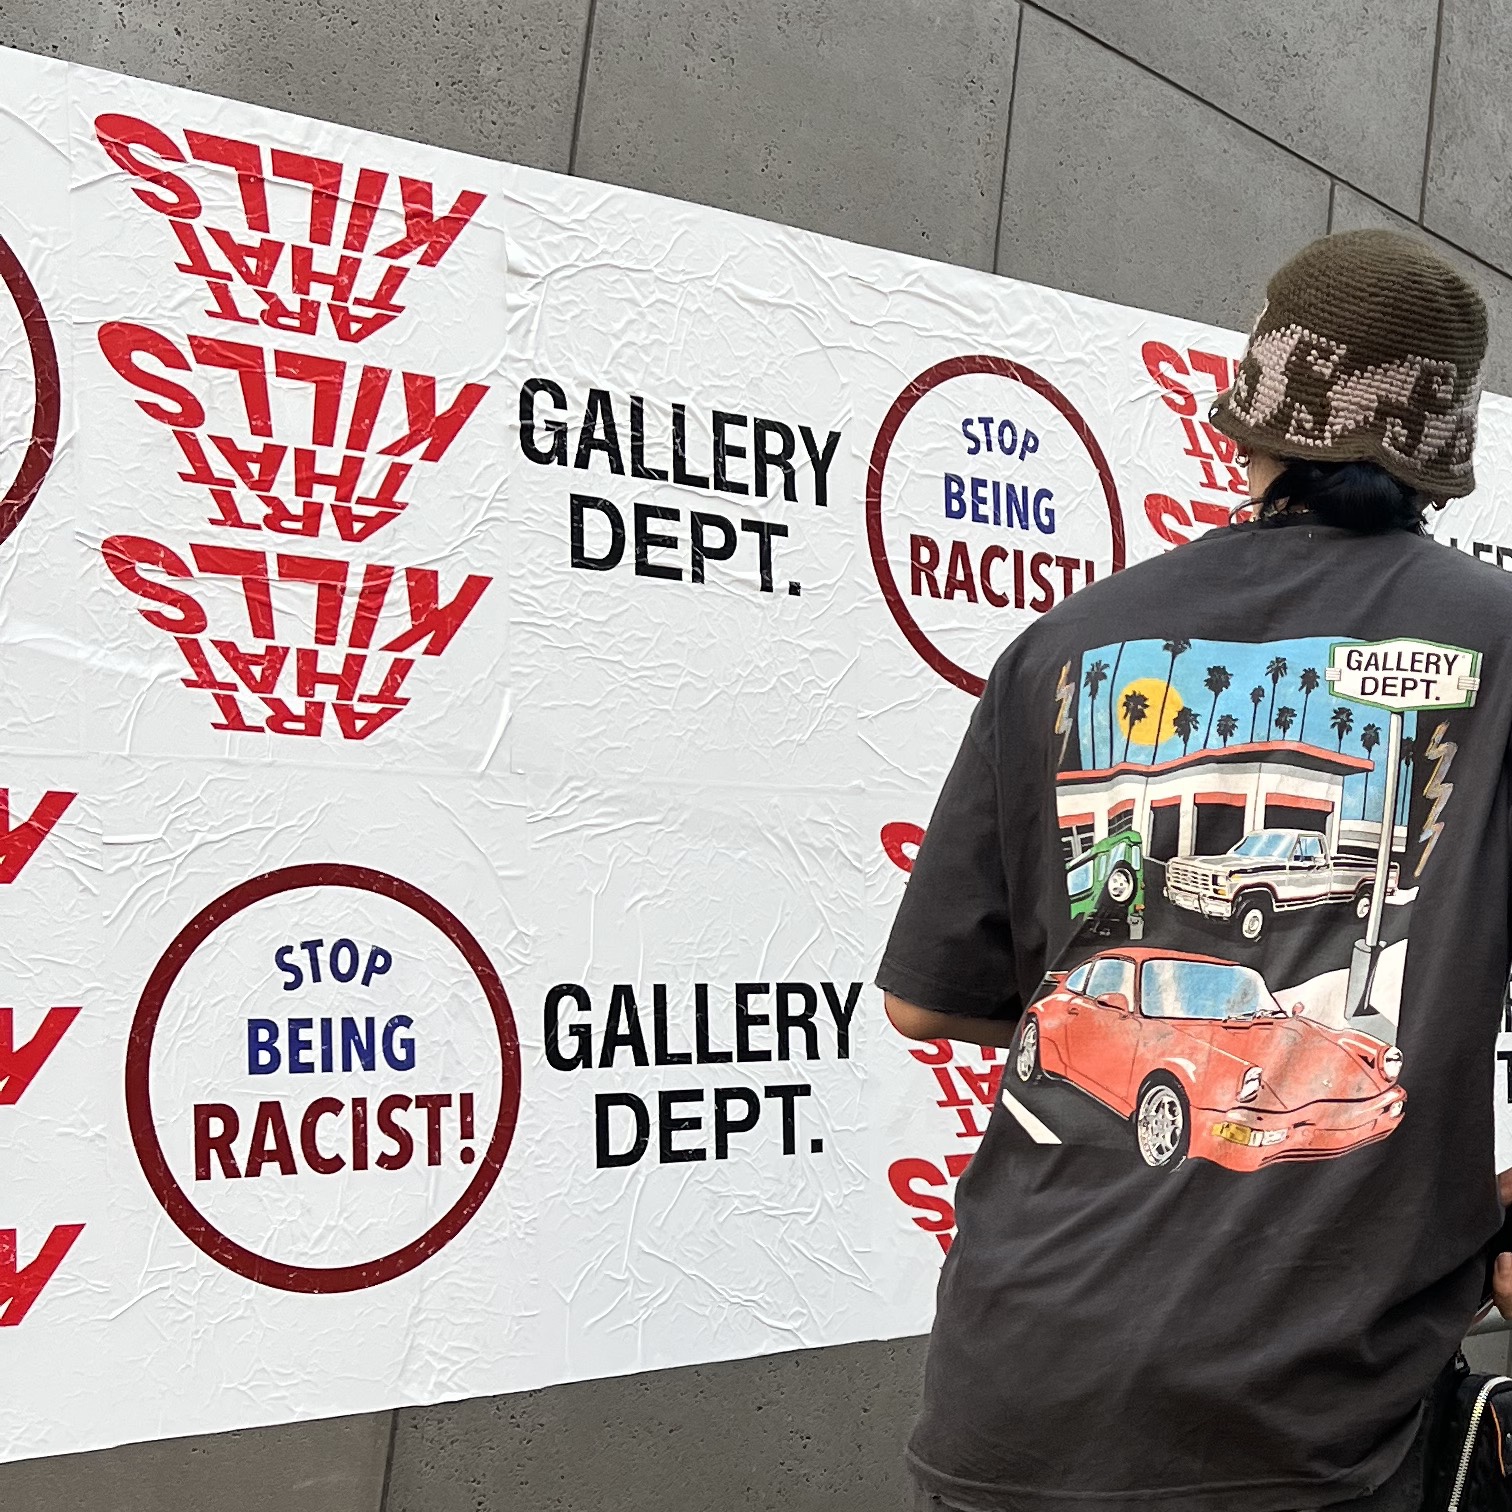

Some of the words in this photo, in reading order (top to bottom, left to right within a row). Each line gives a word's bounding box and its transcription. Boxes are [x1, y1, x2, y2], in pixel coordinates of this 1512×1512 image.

[94, 112, 487, 267] KILLS
[173, 219, 409, 320] THAT
[204, 280, 399, 342] ART
[98, 321, 490, 462] KILLS
[172, 429, 412, 510] THAT
[519, 378, 841, 507] GALLERY
[962, 417, 1039, 461] STOP
[208, 488, 400, 542] ART
[945, 473, 1055, 534] BEING
[570, 493, 801, 596] DEPT.
[101, 535, 493, 656] KILLS
[174, 636, 415, 706] THAT
[1346, 648, 1459, 676] GALLERY
[1361, 677, 1440, 700] DEPT.
[211, 693, 401, 740] ART
[275, 938, 392, 991] STOP
[248, 1015, 415, 1075] BEING
[544, 982, 863, 1071] GALLERY
[194, 1093, 475, 1181] RACIST!
[595, 1084, 823, 1168] DEPT.
